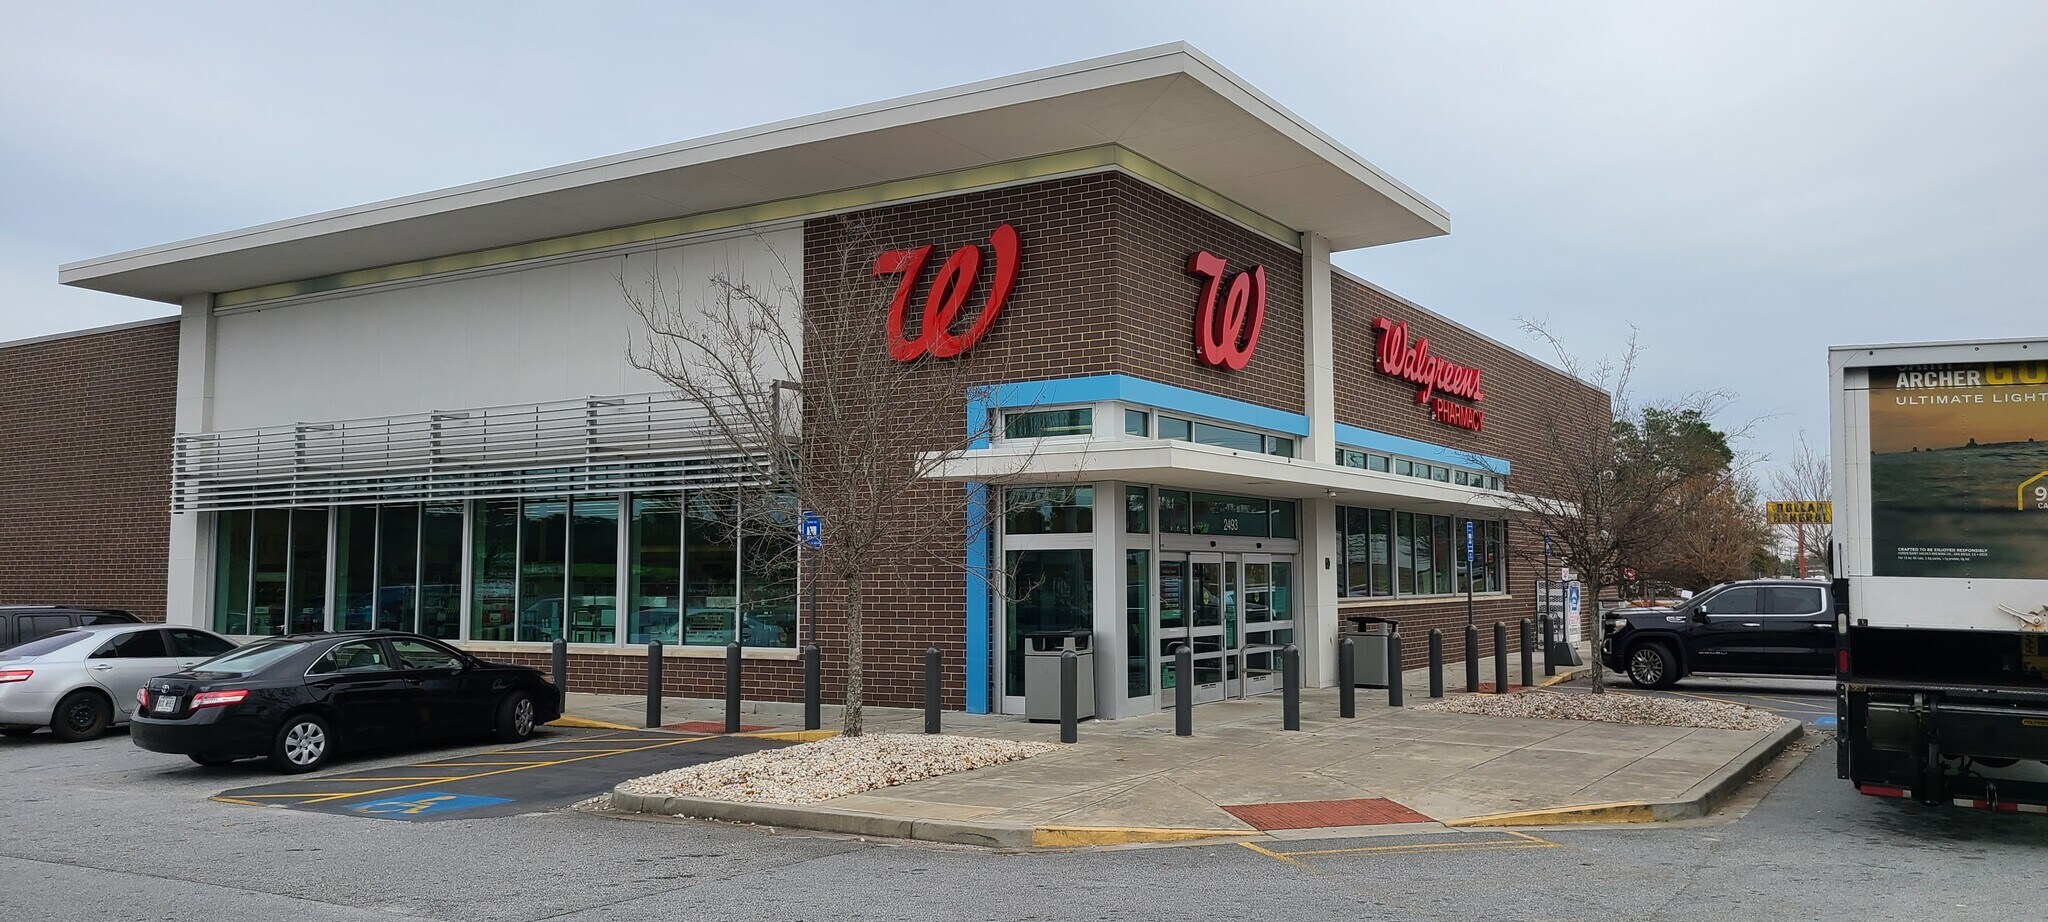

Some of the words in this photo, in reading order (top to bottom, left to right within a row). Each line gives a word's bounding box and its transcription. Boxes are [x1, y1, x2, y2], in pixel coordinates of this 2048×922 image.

[872, 223, 1022, 362] W
[1187, 250, 1266, 371] W
[1373, 317, 1484, 405] Walgreens
[1896, 370, 1982, 390] ARCHER
[1433, 398, 1484, 432] PHARMACY
[1896, 394, 1984, 405] ULTIMATE
[1993, 393, 2048, 403] LIGHT
[1223, 518, 1239, 531] 2493
